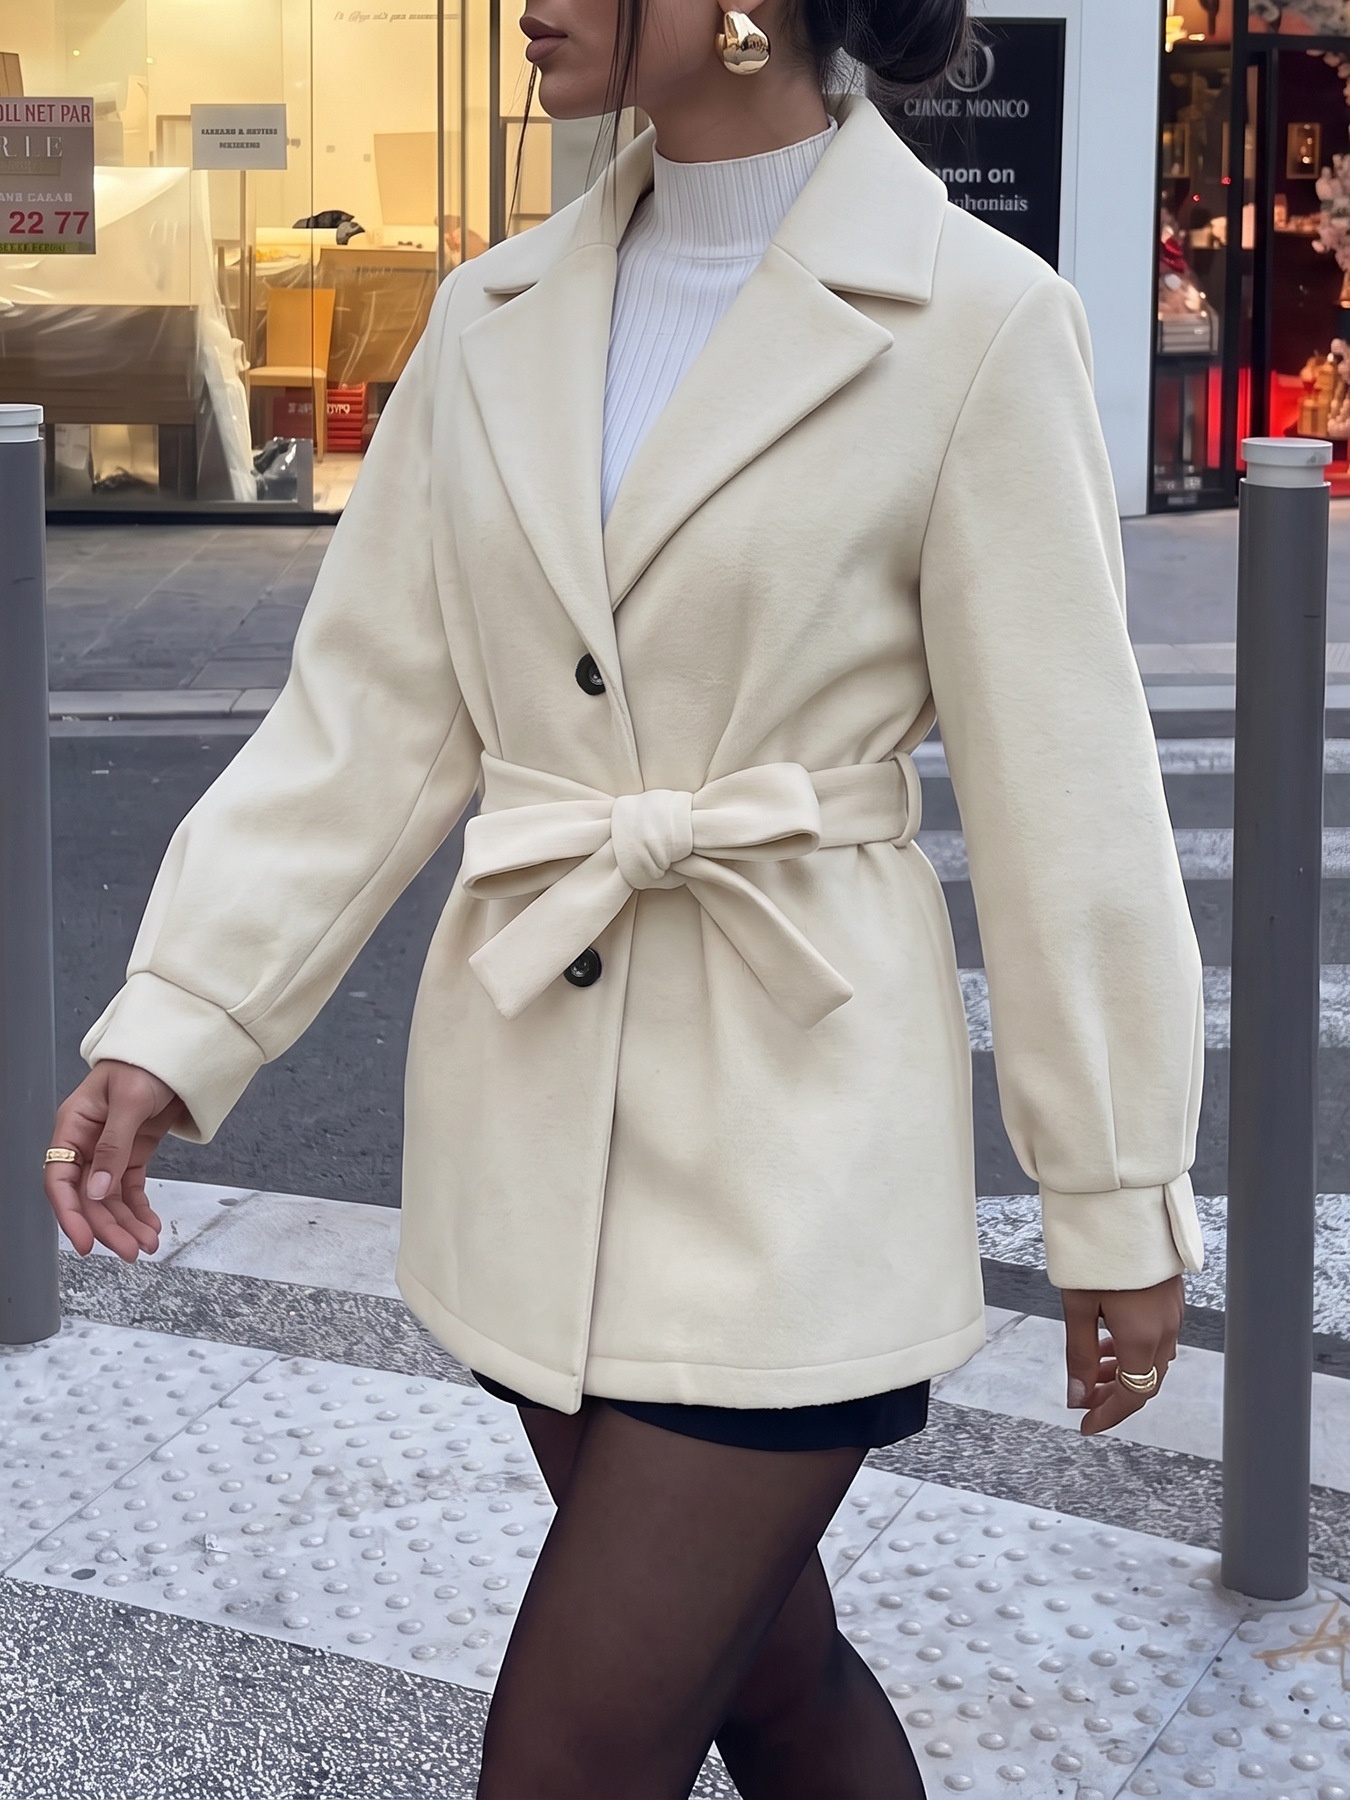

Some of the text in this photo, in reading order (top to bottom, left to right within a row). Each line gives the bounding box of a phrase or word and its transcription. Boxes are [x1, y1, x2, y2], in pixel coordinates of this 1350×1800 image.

[25, 104, 55, 122] NET
[61, 105, 91, 123] PAR
[966, 99, 1029, 118] MONICO
[988, 168, 1015, 183] on
[9, 211, 90, 235] 22 77
